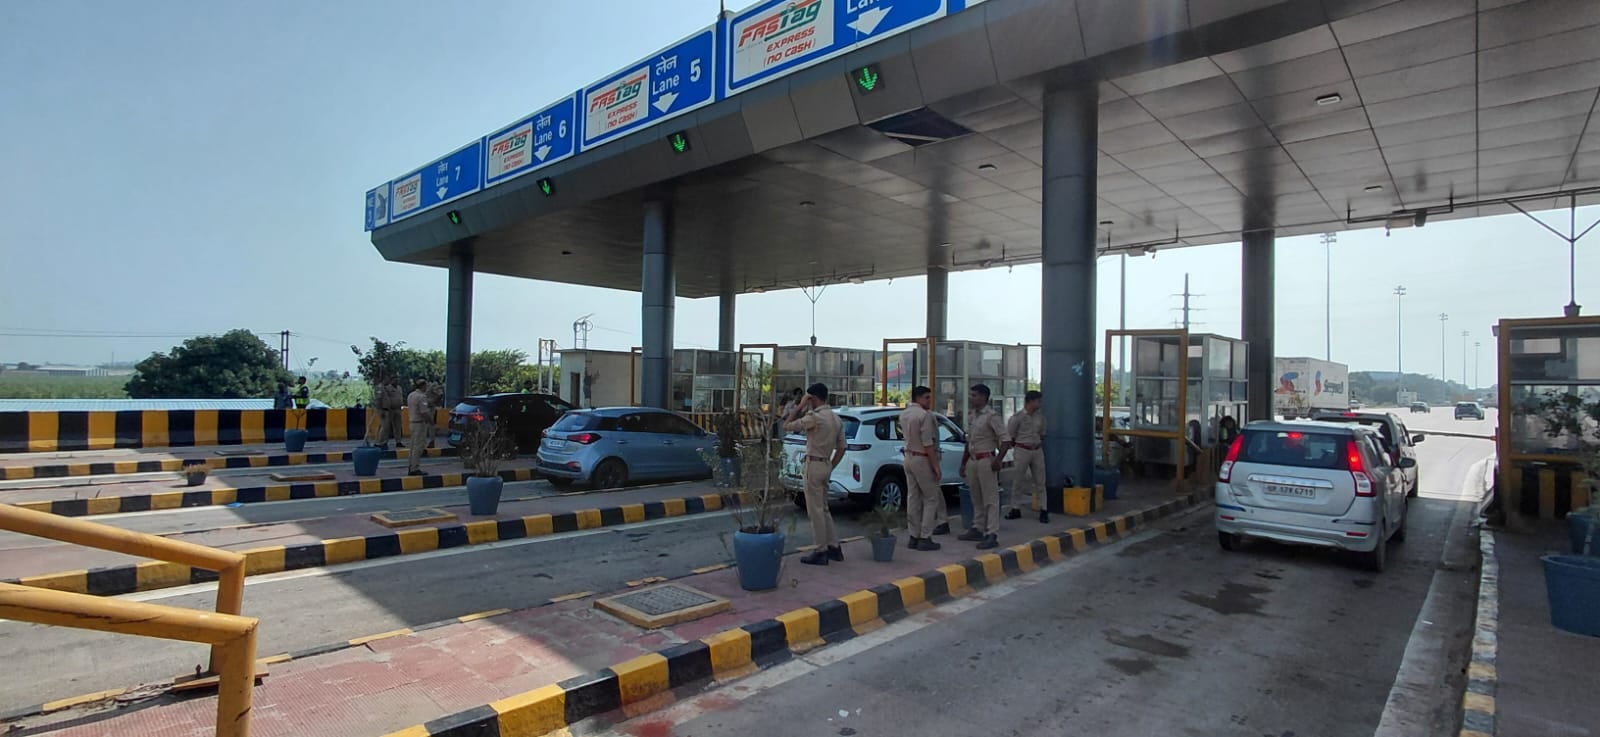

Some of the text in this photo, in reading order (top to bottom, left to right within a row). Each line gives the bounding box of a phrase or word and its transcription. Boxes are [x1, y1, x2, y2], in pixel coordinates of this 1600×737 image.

[847, 0, 881, 14] La
[766, 26, 815, 52] EXPRESS
[655, 55, 678, 76] लेन
[689, 58, 701, 82] 5
[652, 75, 680, 95] Lane
[558, 119, 567, 138] 6
[534, 131, 553, 146] Lane
[455, 165, 461, 181] 7
